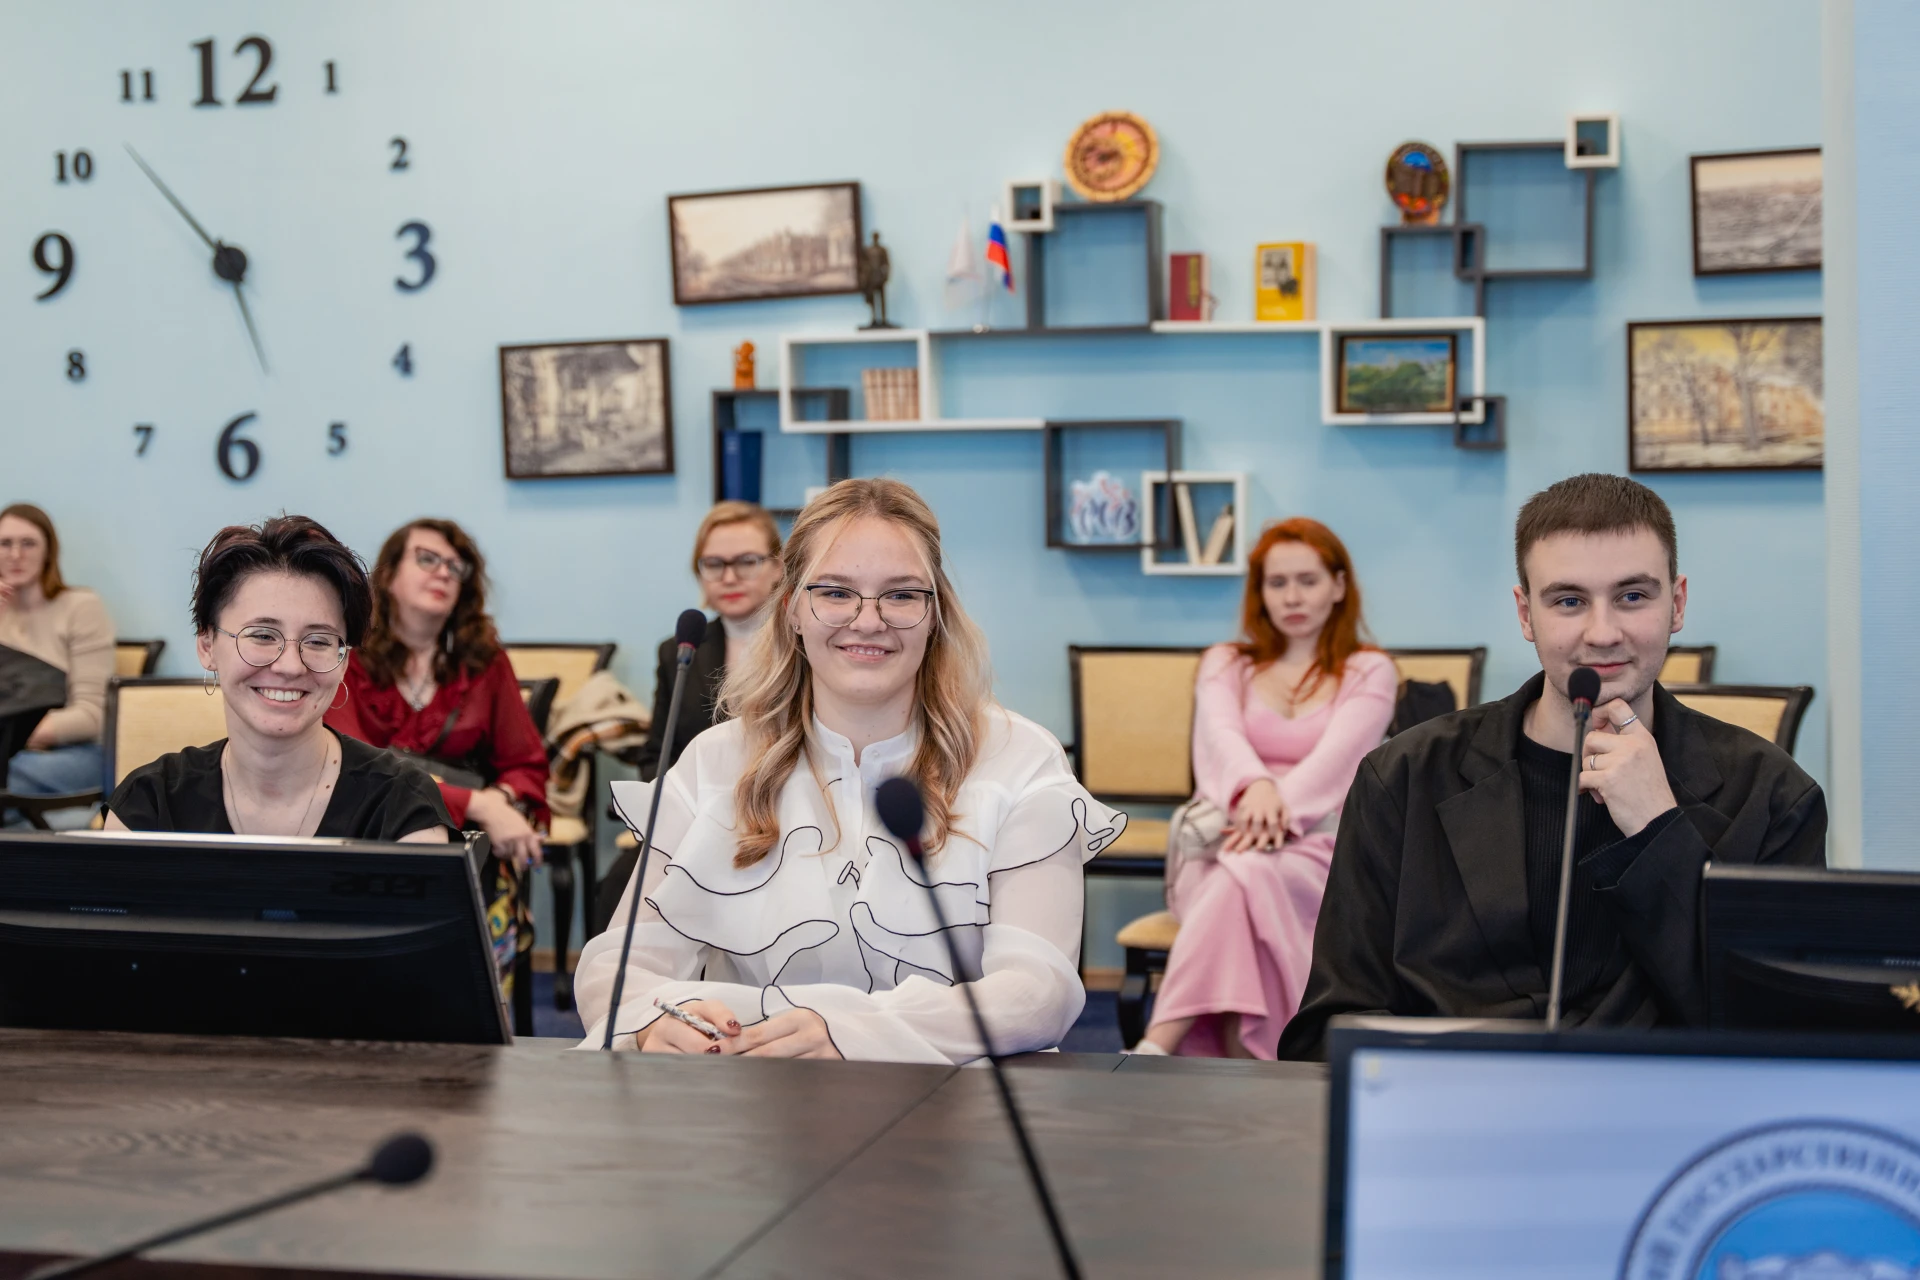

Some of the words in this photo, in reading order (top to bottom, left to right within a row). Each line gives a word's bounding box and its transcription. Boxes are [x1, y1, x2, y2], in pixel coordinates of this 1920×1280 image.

[119, 69, 156, 103] 11
[191, 35, 278, 108] 12
[323, 60, 339, 94] 1
[55, 149, 95, 184] 10
[390, 136, 411, 172] 2
[31, 232, 76, 302] 9
[394, 220, 438, 294] 3
[66, 350, 87, 383] 8
[392, 343, 415, 378] 4
[133, 424, 156, 457] 7
[215, 412, 263, 484] 6
[327, 422, 349, 457] 5
